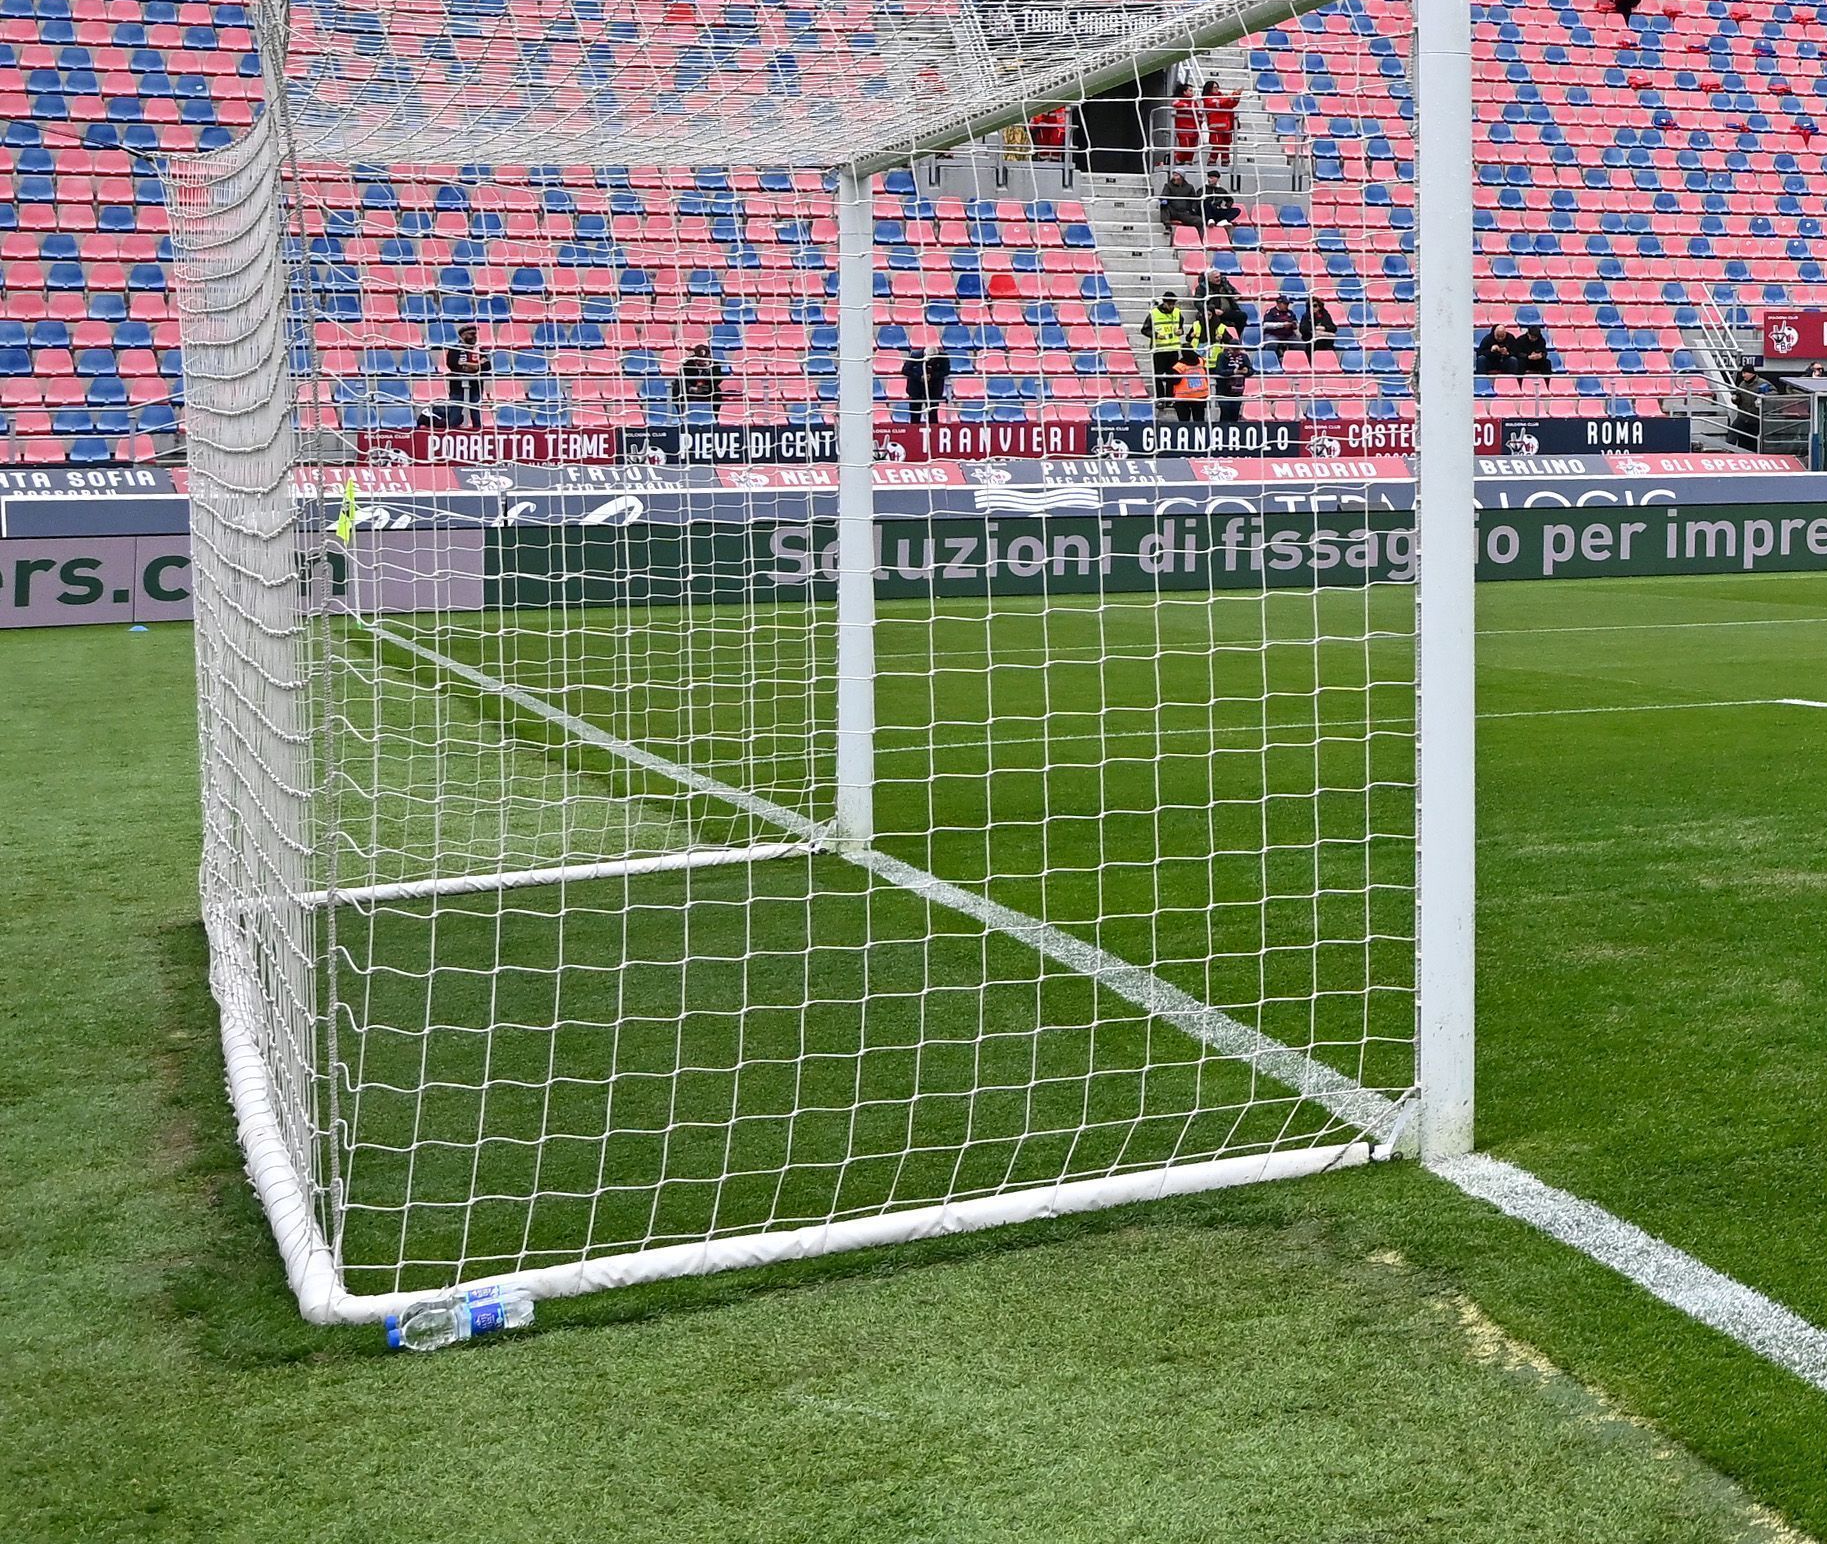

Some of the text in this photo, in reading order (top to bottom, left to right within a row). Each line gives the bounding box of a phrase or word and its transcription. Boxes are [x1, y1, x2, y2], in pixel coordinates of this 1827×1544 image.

[919, 427, 1075, 453] TRANVIERI
[1142, 426, 1289, 452] GRANAROLO
[1587, 421, 1643, 445] ROMA
[428, 433, 608, 460] PORRETTA TERME
[680, 432, 741, 460] PIEVE
[752, 432, 770, 459] DI
[784, 468, 948, 486] NEW LEANS
[1272, 462, 1377, 478] MADRID
[1479, 459, 1586, 474] BERLINO
[1660, 458, 1790, 472] GLI SPECIALI
[67, 470, 156, 487] SOFIA
[1138, 518, 1196, 574] di
[1222, 512, 1519, 581] fissago
[1543, 520, 1647, 576] per
